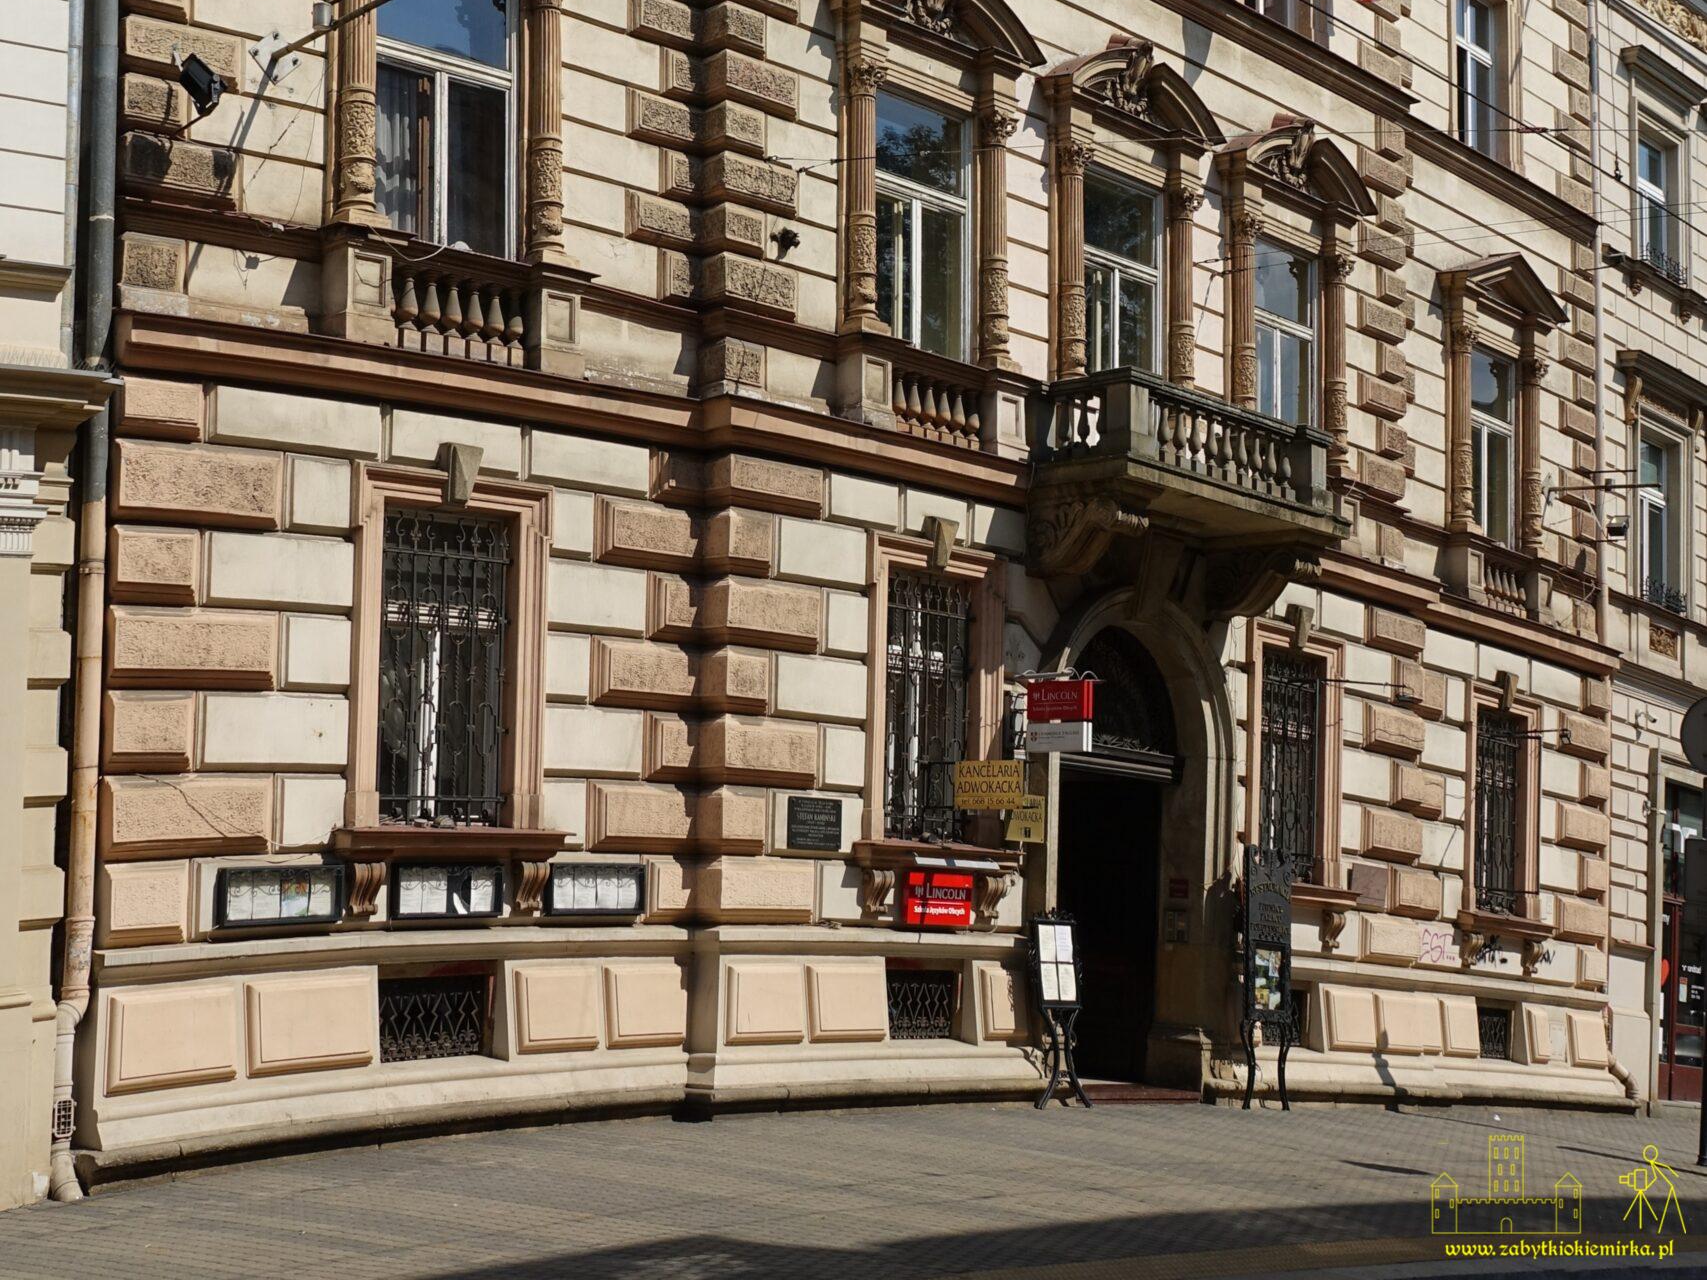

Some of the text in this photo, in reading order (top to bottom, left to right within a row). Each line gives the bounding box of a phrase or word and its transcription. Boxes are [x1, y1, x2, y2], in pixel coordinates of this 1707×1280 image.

[1041, 688, 1078, 701] LINCOLN
[958, 764, 1020, 778] KANCELARIA
[956, 780, 1022, 794] ADWOKACKA
[987, 797, 994, 805] 15
[1006, 797, 1015, 805] 44
[925, 882, 967, 900] LINCOLN
